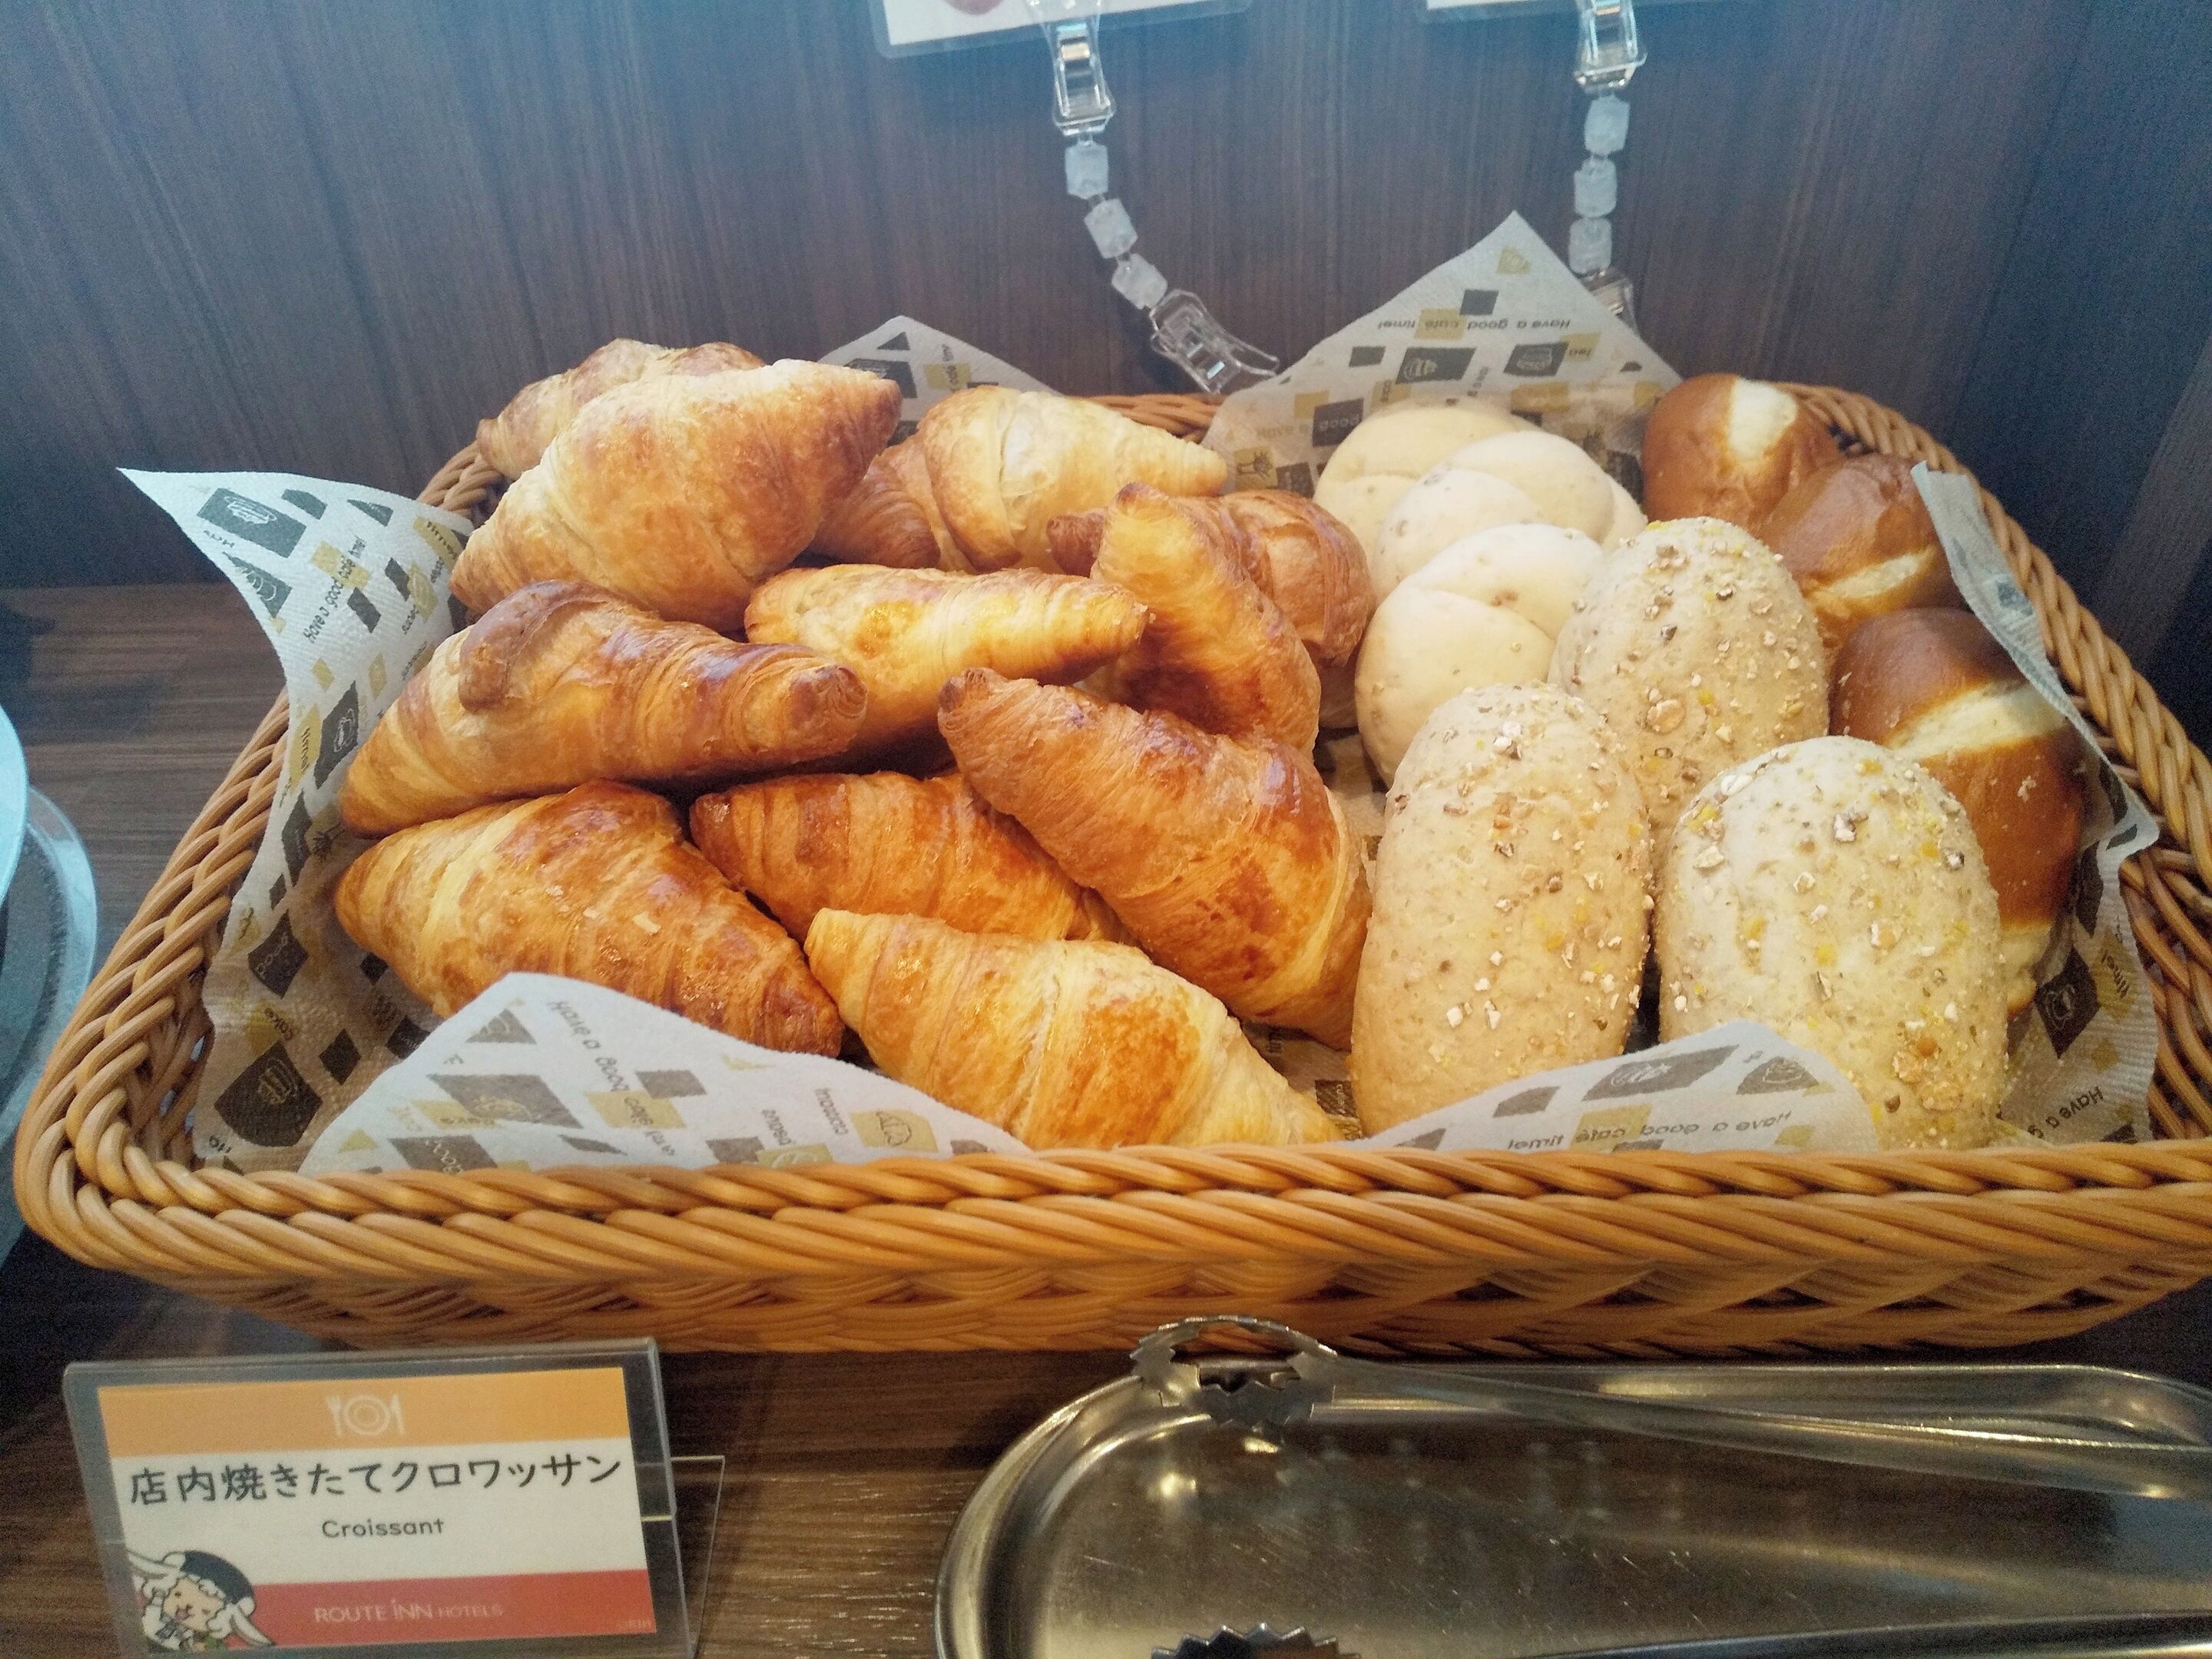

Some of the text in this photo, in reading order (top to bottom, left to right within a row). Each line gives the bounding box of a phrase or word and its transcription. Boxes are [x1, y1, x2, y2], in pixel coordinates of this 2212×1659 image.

[1467, 318, 1508, 330] good
[1532, 319, 1571, 329] Have
[2059, 1086, 2104, 1119] Have
[2045, 1116, 2059, 1128] a
[131, 1454, 621, 1505] 店内焼きたてクロワッサン
[321, 1517, 444, 1538] Croissant
[314, 1605, 385, 1623] ROUTE
[438, 1603, 504, 1620] HOTELS
